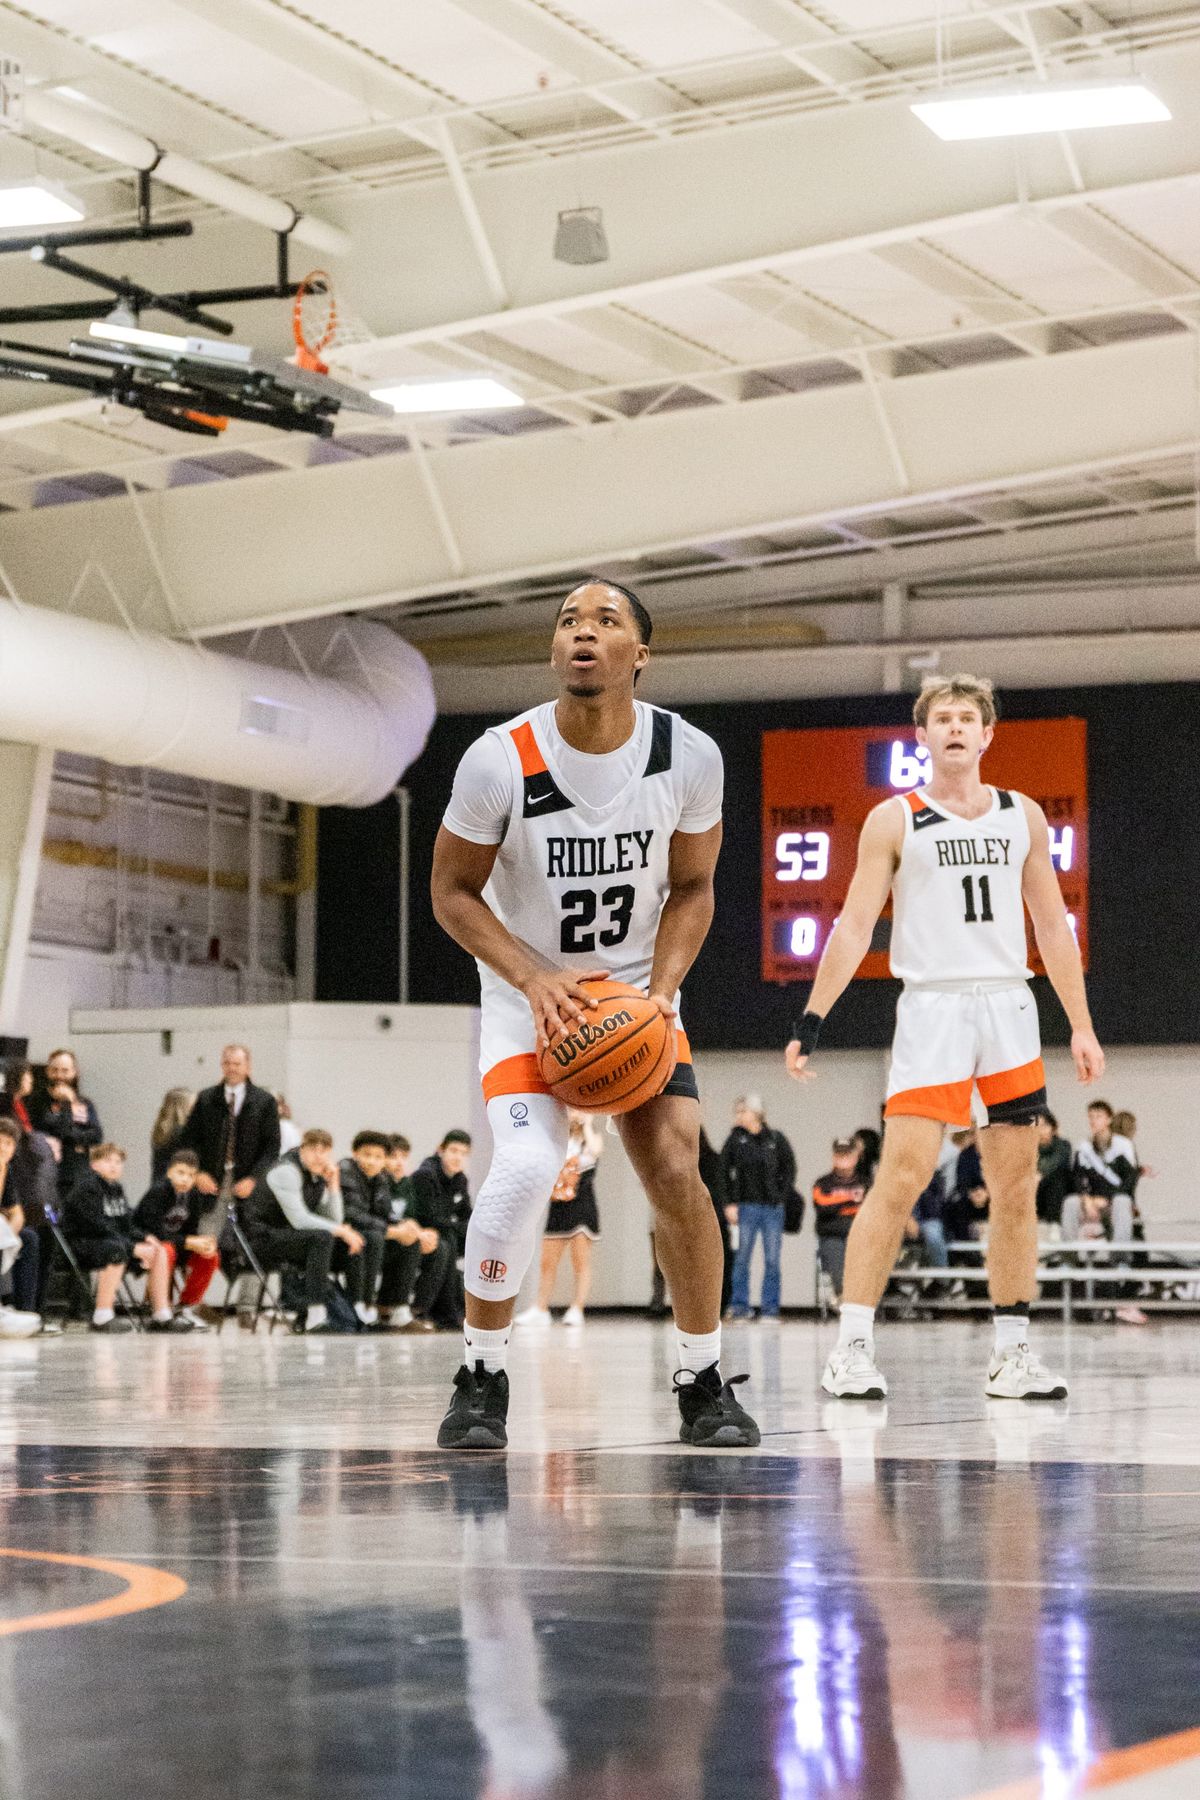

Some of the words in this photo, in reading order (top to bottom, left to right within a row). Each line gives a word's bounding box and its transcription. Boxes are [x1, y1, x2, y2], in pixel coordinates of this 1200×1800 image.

[547, 829, 654, 878] RIDLEY
[775, 832, 830, 881] 53
[935, 838, 1010, 867] RIDLEY
[560, 883, 636, 954] 23
[961, 875, 994, 922] 11
[791, 917, 817, 956] 0
[551, 1009, 635, 1068] Wilson
[578, 1042, 652, 1096] EVOLUTION
